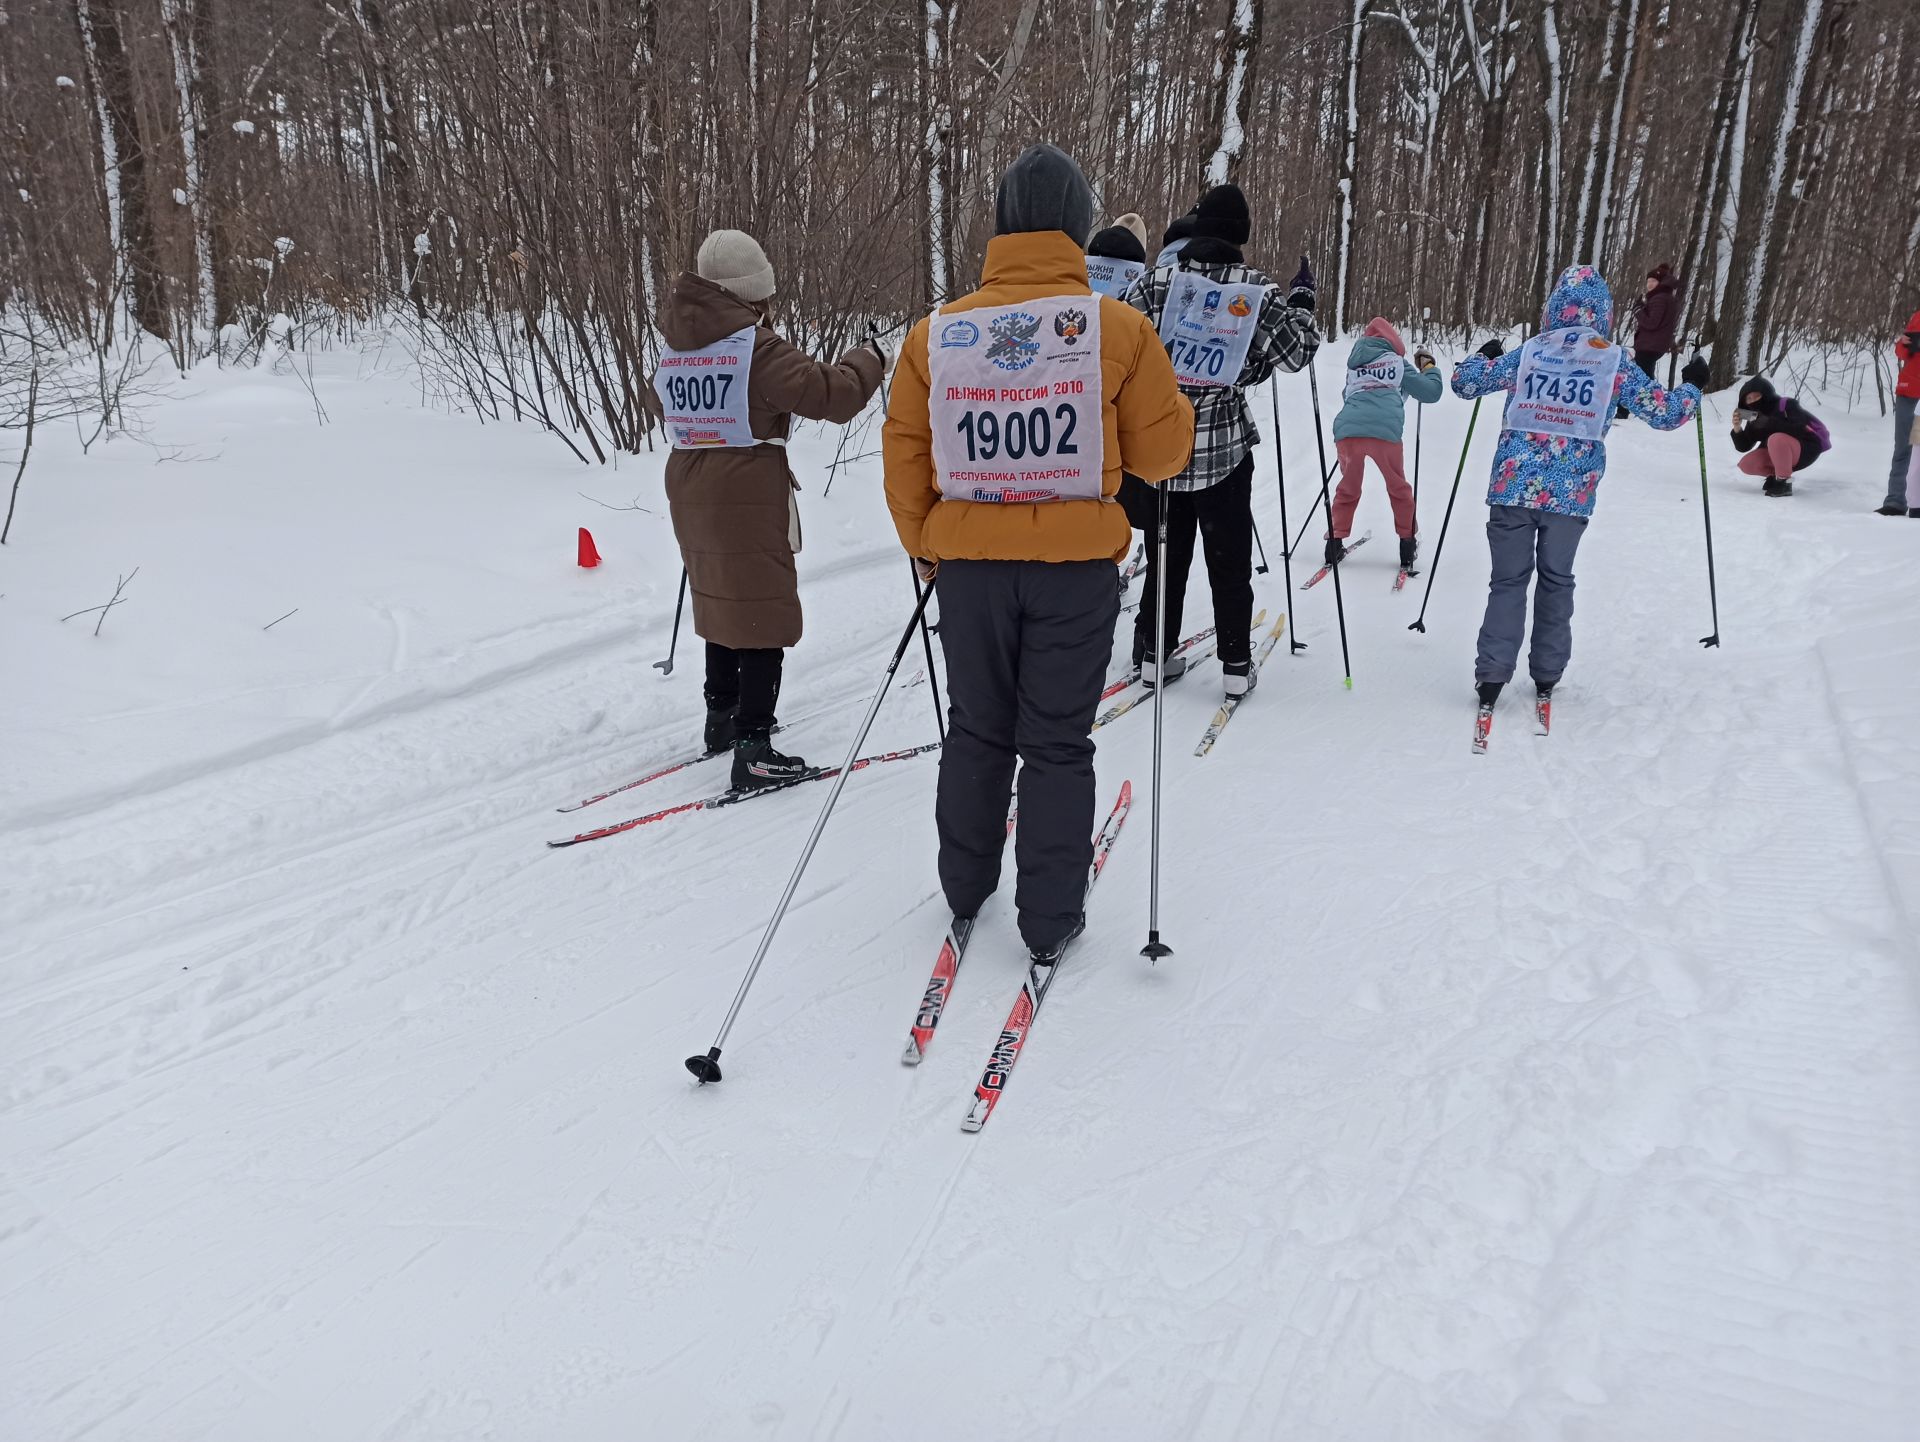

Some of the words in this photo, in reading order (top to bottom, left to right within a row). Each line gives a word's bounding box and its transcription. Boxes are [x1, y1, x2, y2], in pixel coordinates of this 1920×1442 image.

[1087, 272, 1112, 281] ОССИИ
[683, 357, 713, 366] РОССИИ
[716, 356, 738, 365] 2010
[992, 357, 1034, 371] РОССИИ
[666, 373, 733, 411] 19007
[945, 387, 996, 401] ЛЫЖНЯ
[1001, 385, 1048, 402] РОССИИ
[1054, 380, 1083, 395] 2010
[1525, 373, 1595, 406] 17436
[1535, 404, 1564, 414] ЛЫЖНЯ
[1565, 408, 1596, 418] РОССИИ
[695, 416, 736, 424] ТАТАРСТАН
[1534, 412, 1574, 425] КАЗАНЬ
[957, 403, 1078, 461] 19002
[949, 471, 1016, 482] РЕСПУБЛИКА
[1019, 468, 1080, 481] ТАТАРСТАН
[755, 761, 802, 771] SPINE
[915, 977, 947, 1029] OMNI
[978, 1030, 1020, 1091] OMNI
